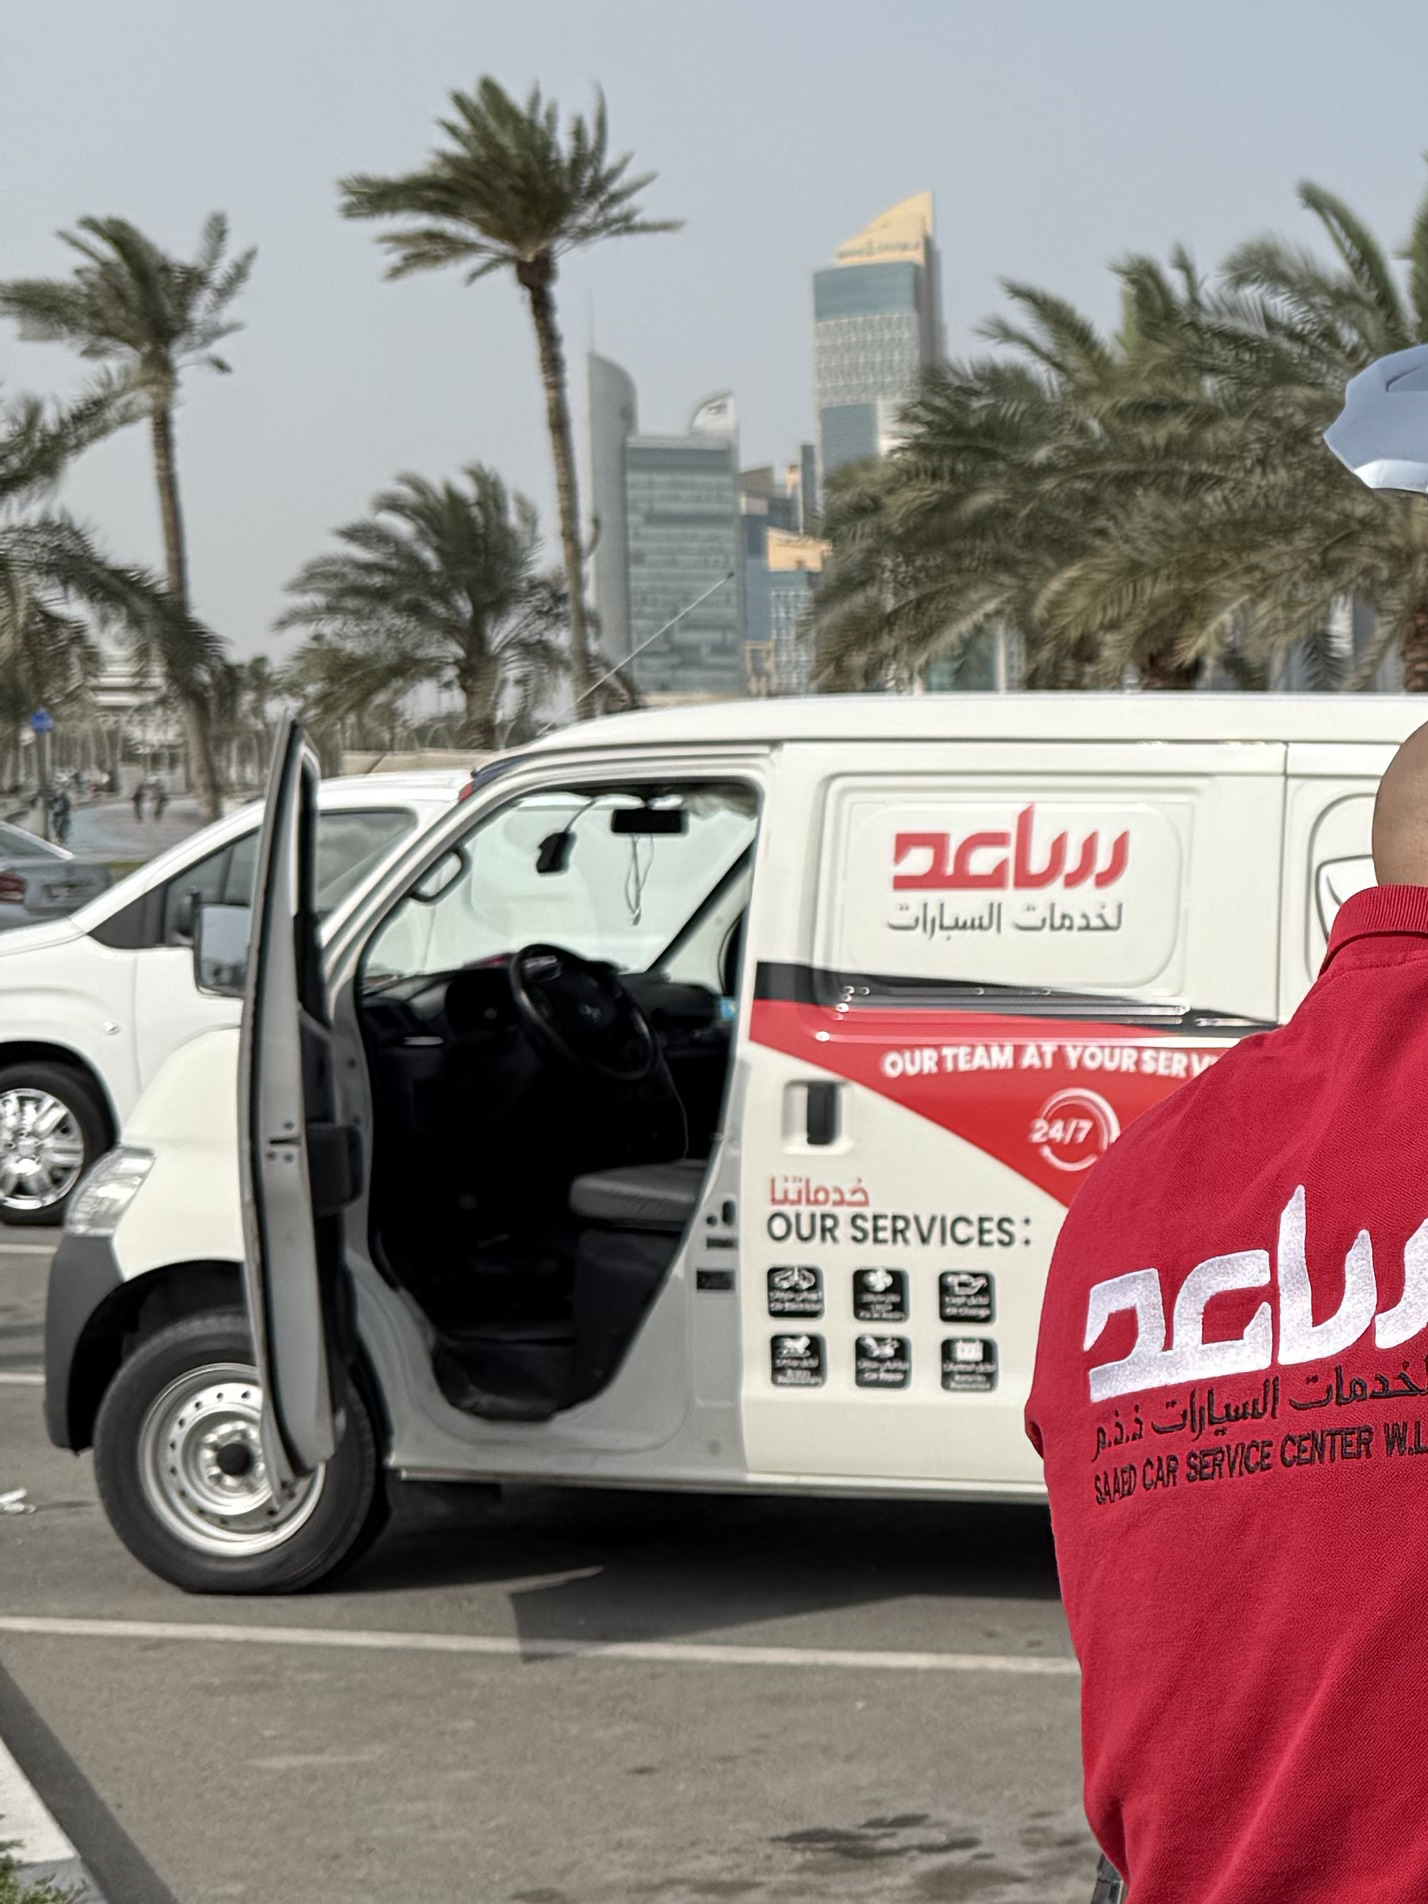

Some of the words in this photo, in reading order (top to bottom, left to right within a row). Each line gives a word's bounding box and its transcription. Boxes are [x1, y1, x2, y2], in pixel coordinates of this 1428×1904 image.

[886, 901, 1002, 941] السيارات
[1013, 901, 1123, 933] لخدمات
[882, 1046, 939, 1078] OUR
[942, 1041, 1015, 1072] TEAM
[1020, 1043, 1059, 1070] AT
[1064, 1041, 1137, 1073] YOUR
[1030, 1118, 1093, 1145] 24/7
[768, 1174, 870, 1207] خدماتنا
[767, 1211, 840, 1244] OUR
[1151, 1374, 1280, 1442] السيارات
[1094, 1462, 1137, 1505] SAAED
[1142, 1453, 1180, 1491] CAR
[1186, 1438, 1274, 1483] SERVICE
[1281, 1424, 1374, 1468] CENTER
